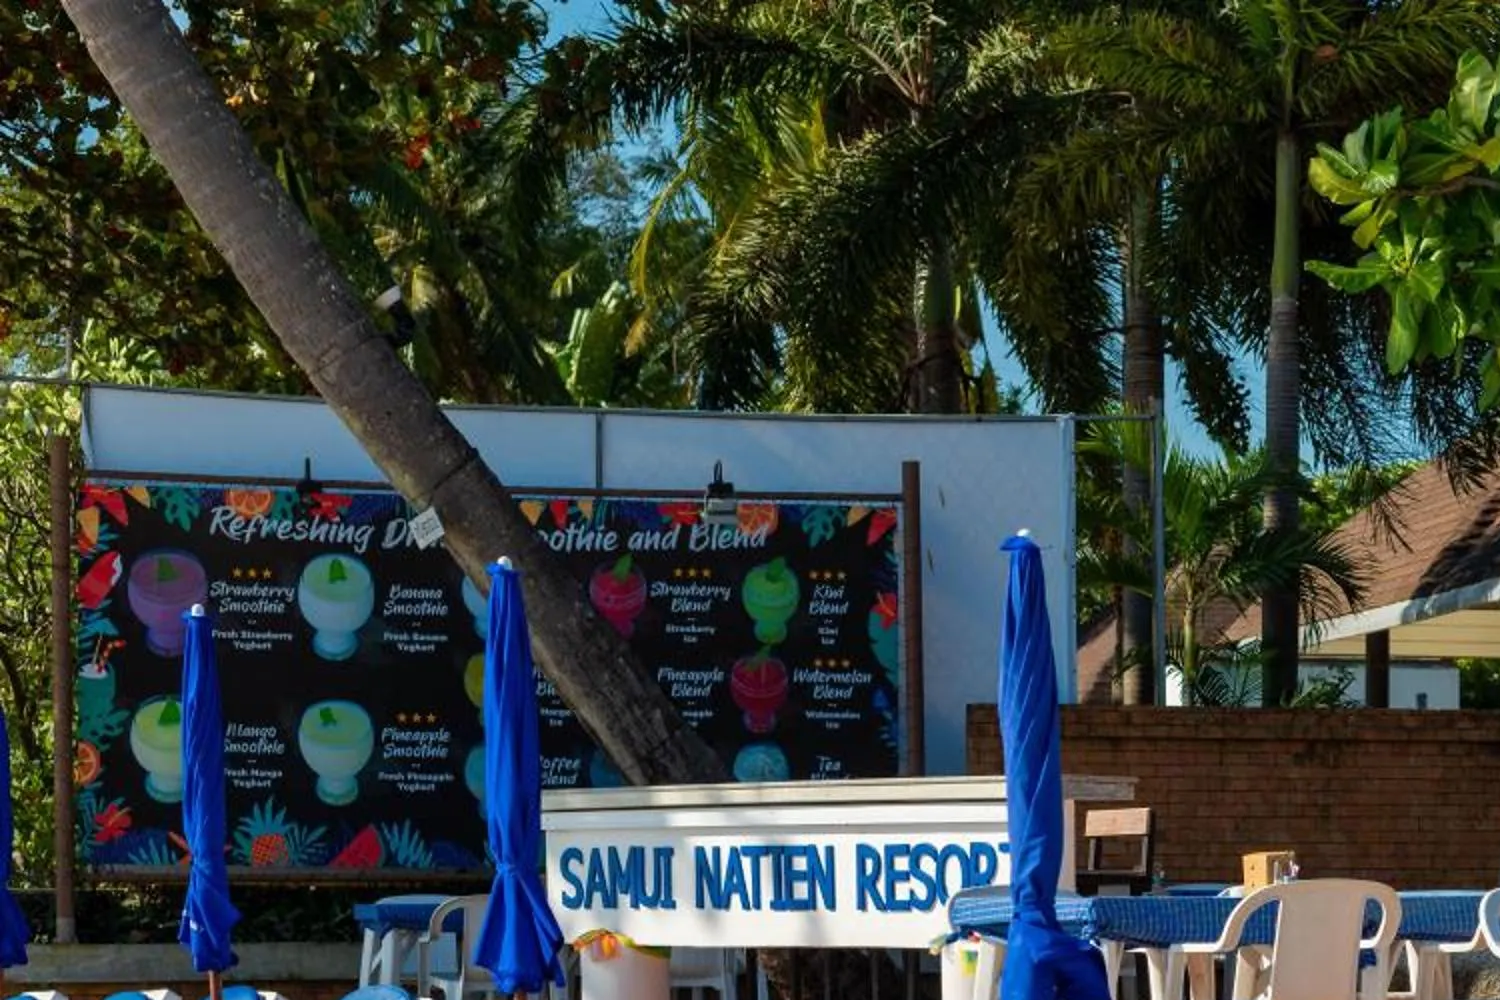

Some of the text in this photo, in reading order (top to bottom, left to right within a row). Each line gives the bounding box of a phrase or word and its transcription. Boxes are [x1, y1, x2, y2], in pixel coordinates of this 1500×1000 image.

[209, 506, 375, 555] Refreshing
[628, 523, 680, 550] and
[689, 522, 768, 552] Blend
[209, 581, 295, 602] Strawberry
[389, 583, 443, 600] Banana
[651, 583, 731, 601] Strawberry
[814, 585, 845, 599] Kiwi
[219, 599, 285, 614] Smoothie
[384, 600, 449, 616] Smoothie
[671, 598, 711, 613] Blend
[809, 600, 849, 615] Blend
[657, 667, 725, 685] Pineapple
[793, 668, 872, 684] Watermelon
[671, 683, 711, 698] Blend
[813, 685, 853, 700] Blend
[226, 723, 277, 740] Mango
[381, 727, 451, 745] Pineapple
[383, 743, 449, 759] Smoothie
[540, 756, 581, 775] offee
[815, 755, 841, 772] Tea
[559, 841, 1012, 914] SAMUI NATIEN RESOR
